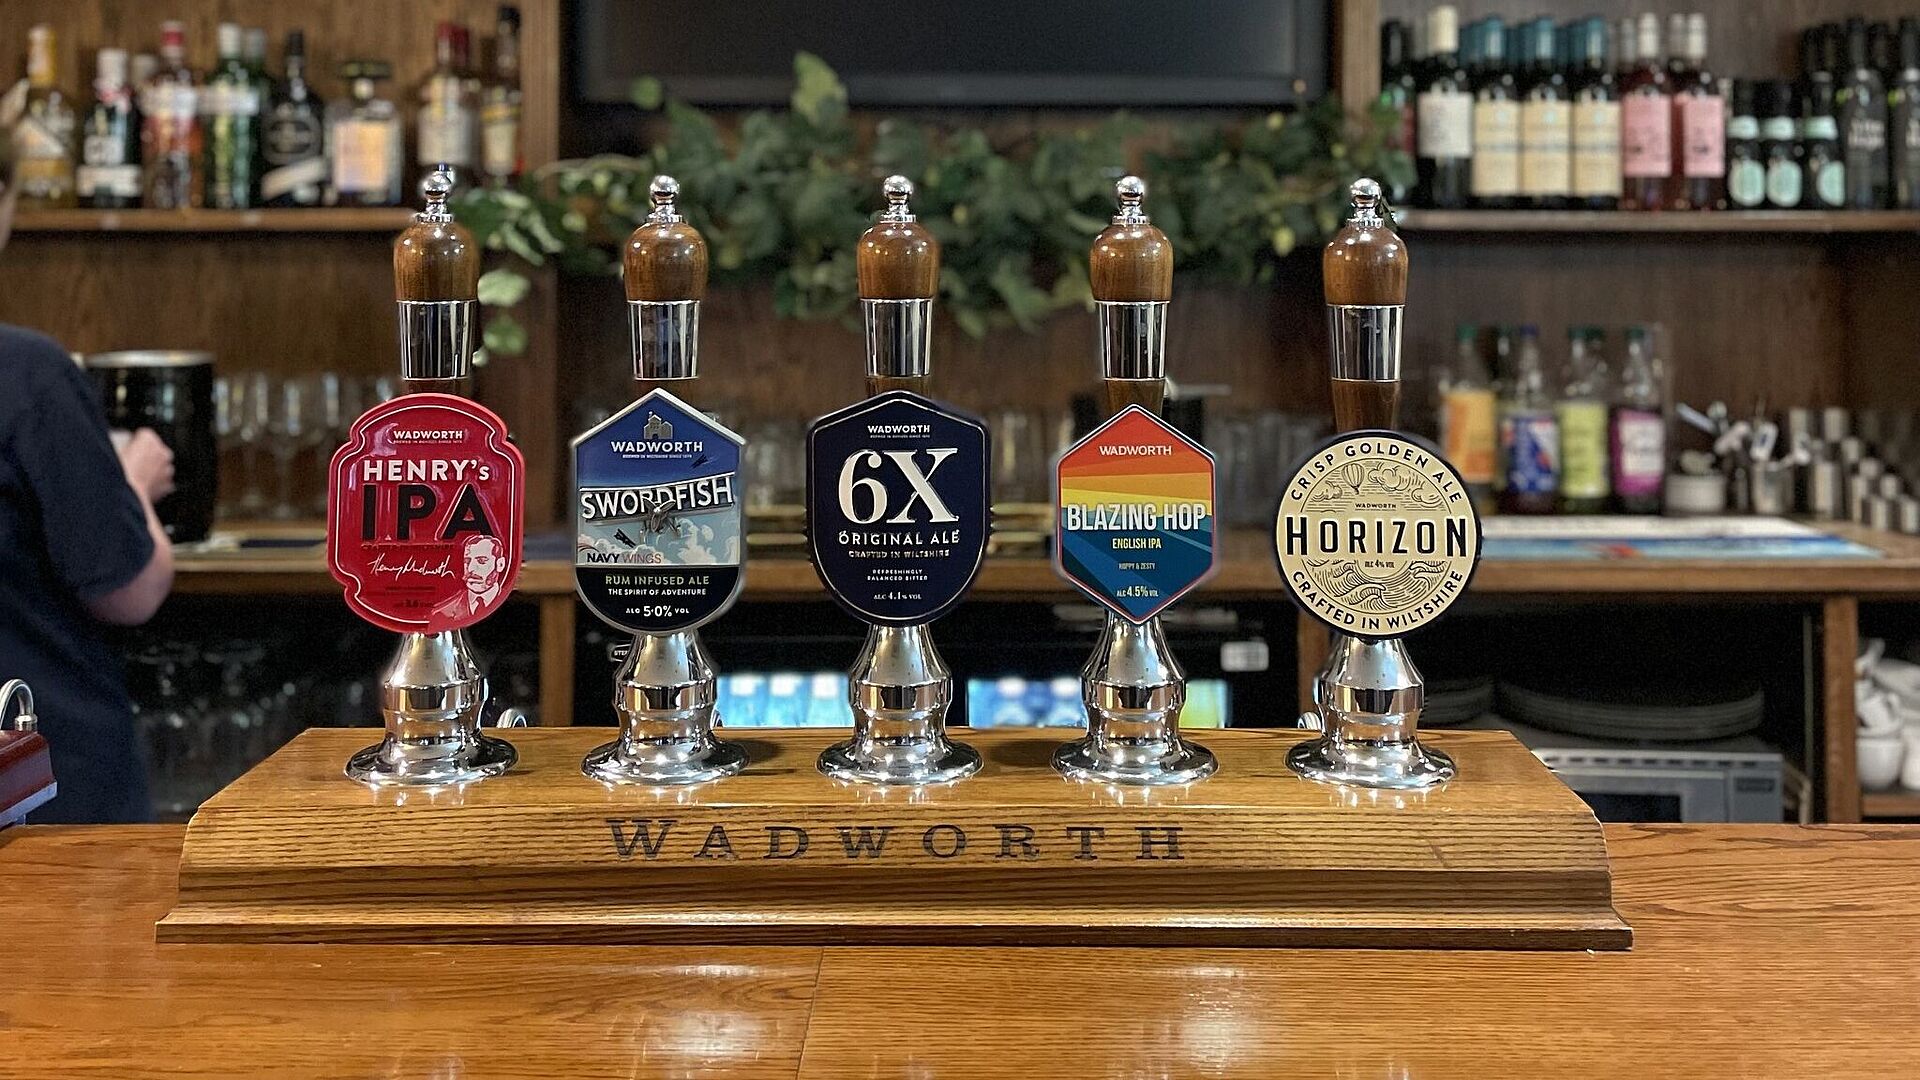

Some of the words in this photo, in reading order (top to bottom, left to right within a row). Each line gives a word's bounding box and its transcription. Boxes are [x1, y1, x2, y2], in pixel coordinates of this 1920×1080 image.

[393, 430, 463, 439] WADWORTH
[868, 425, 930, 433] WADWORTH
[611, 441, 703, 453] WADWORTH
[1099, 446, 1172, 456] WADWORTH
[363, 459, 490, 481] HENRY's
[1291, 453, 1334, 501] CRISP
[1345, 442, 1428, 468] GOLDEN
[1433, 472, 1462, 503] ALE
[838, 448, 960, 524] 6X
[580, 476, 733, 519] SWORDFISH
[363, 484, 494, 540] IPA
[1067, 504, 1158, 531] BLAZING
[1163, 504, 1206, 531] HOP
[839, 532, 923, 545] ORIGINAL
[930, 530, 960, 544] ALE
[1286, 516, 1467, 557] HORIZON
[1112, 538, 1147, 549] ENGLISH
[1148, 538, 1162, 549] IPA
[587, 553, 620, 563] NAVY
[622, 554, 662, 564] WINGS
[904, 550, 950, 558] WILTSHIRE
[606, 576, 630, 585] RUM
[634, 576, 684, 585] INFUSED
[688, 576, 710, 585] ALE
[608, 588, 622, 596] THE
[624, 588, 647, 596] SPIRIT
[649, 588, 659, 596] OF
[661, 588, 706, 596] ADVENTURE
[1127, 586, 1148, 597] 4.5%
[1293, 571, 1355, 625] CRAFTED
[1362, 617, 1379, 629] IN
[1387, 571, 1463, 629] WILTSHIRE
[605, 818, 1186, 861] WADWORTH
